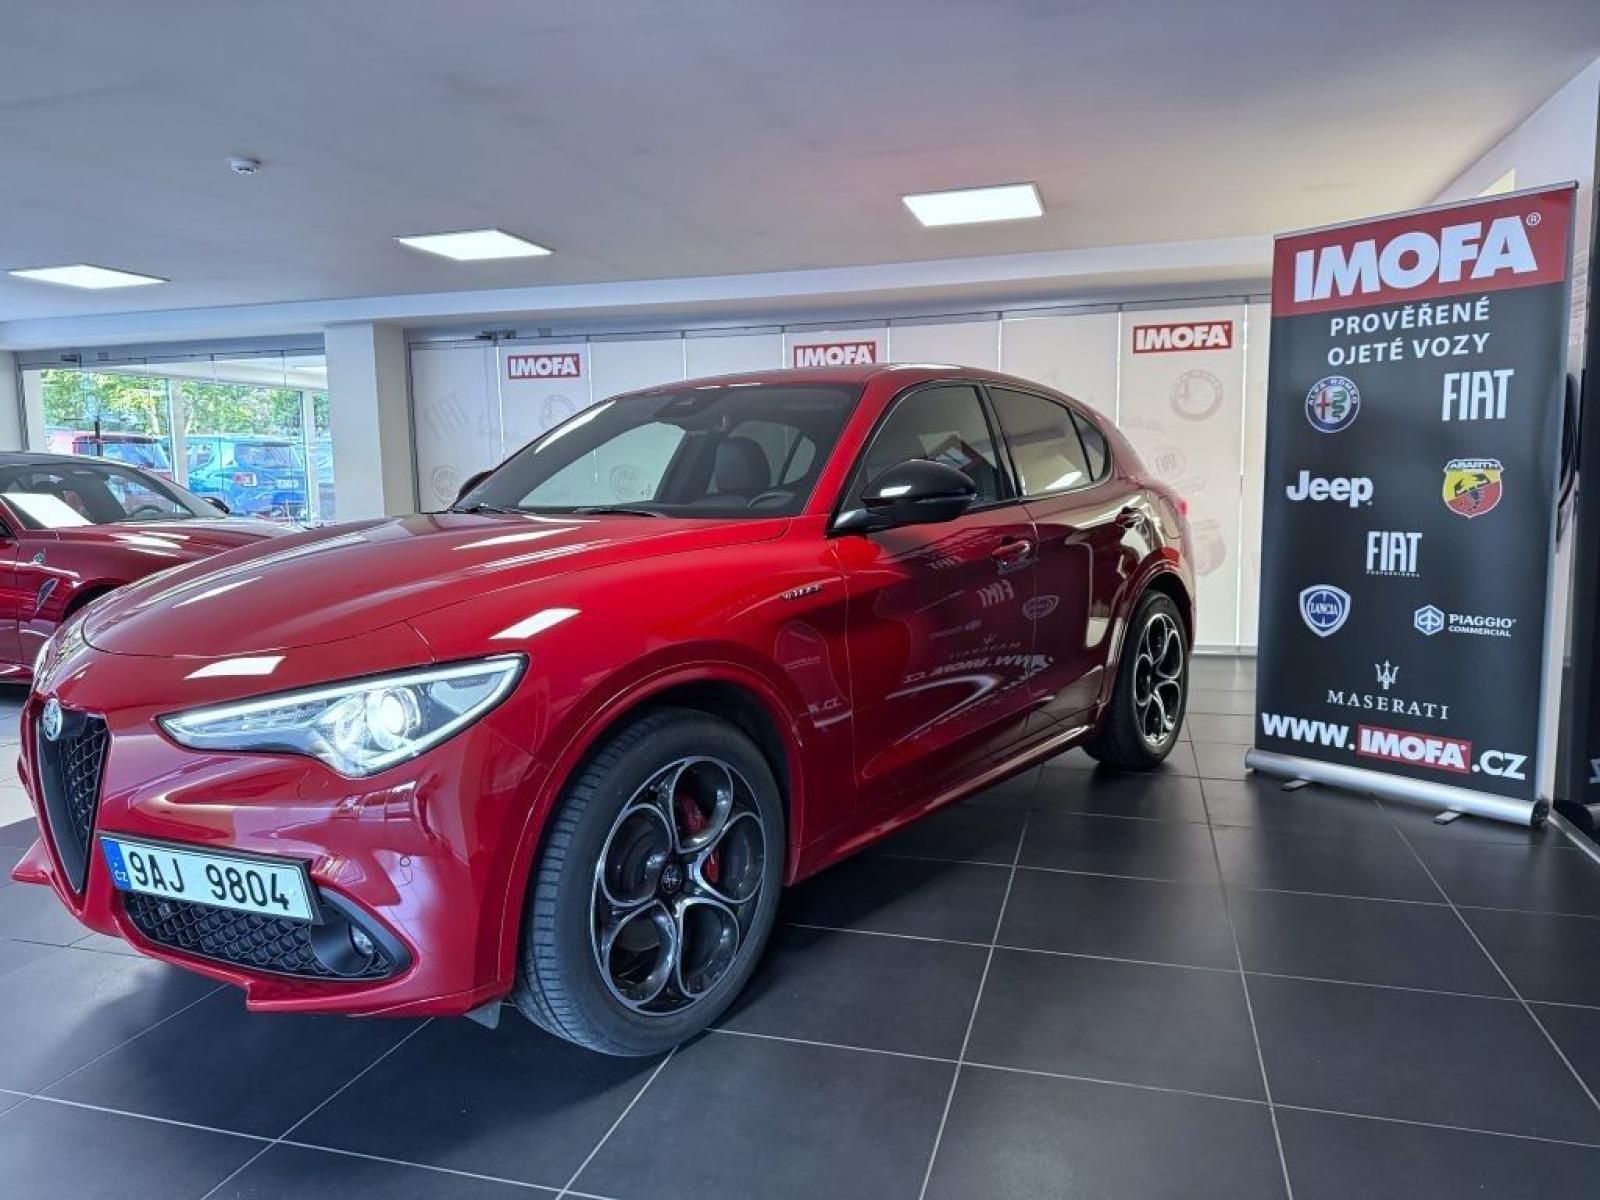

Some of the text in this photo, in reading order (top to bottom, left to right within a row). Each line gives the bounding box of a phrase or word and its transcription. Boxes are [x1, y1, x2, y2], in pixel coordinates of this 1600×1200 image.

[1330, 296, 1490, 337] PROVĚŘENÉ
[1136, 325, 1228, 350] IMOFA
[1327, 332, 1490, 366] OJETÉ VOZY
[511, 355, 578, 376] IMOFA
[1442, 369, 1514, 421] FIAT
[1286, 471, 1373, 508] Jeep
[1366, 531, 1422, 573] FIAT
[1448, 613, 1512, 629] PIAGGIO
[1448, 625, 1511, 637] COMMERCIAL
[1327, 689, 1449, 720] MASERATI
[129, 851, 290, 911] 9AJ 9804
